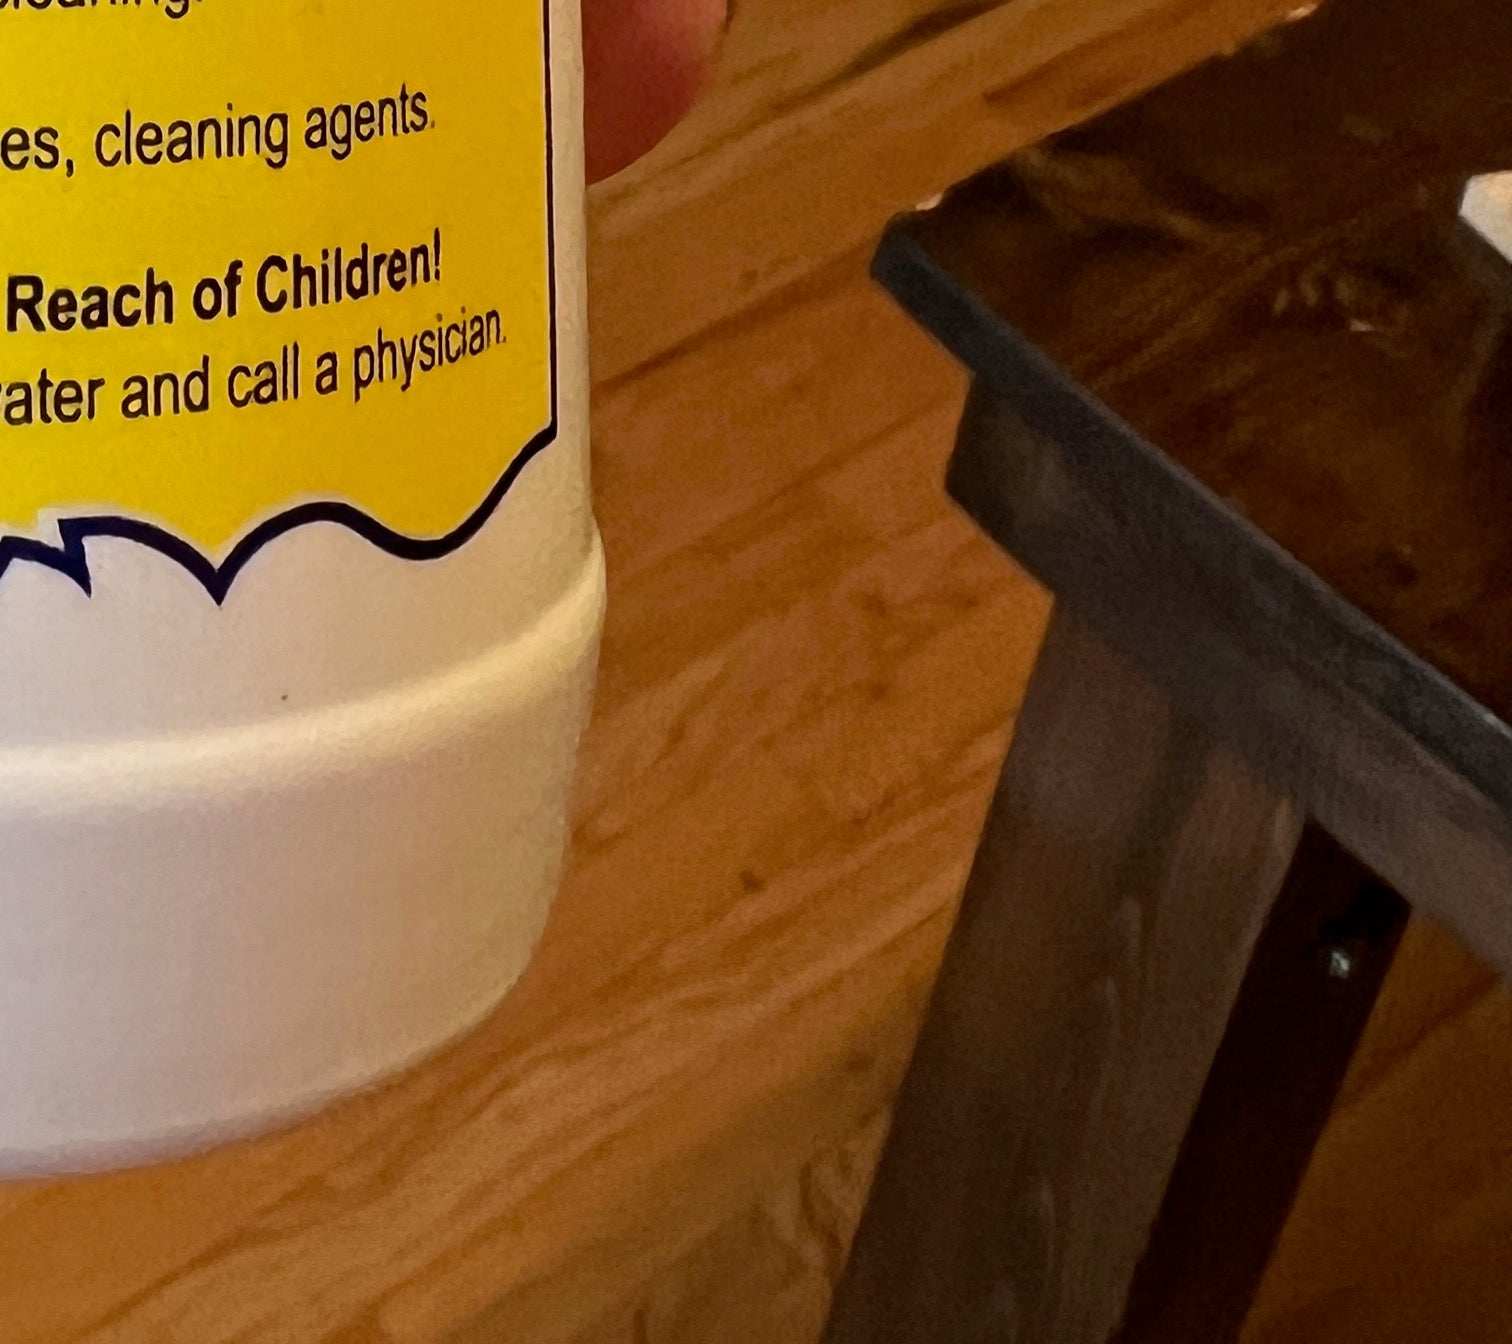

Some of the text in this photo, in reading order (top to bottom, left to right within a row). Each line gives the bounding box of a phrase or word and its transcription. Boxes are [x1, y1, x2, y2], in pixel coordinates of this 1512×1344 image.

[94, 102, 289, 170] cleaning
[304, 83, 435, 161] agents.
[6, 266, 174, 333] Reach
[192, 259, 244, 321] of
[256, 226, 441, 314] Children!
[121, 354, 210, 419] and
[227, 341, 300, 409] call
[315, 351, 338, 396] a
[353, 306, 509, 403] physician.
